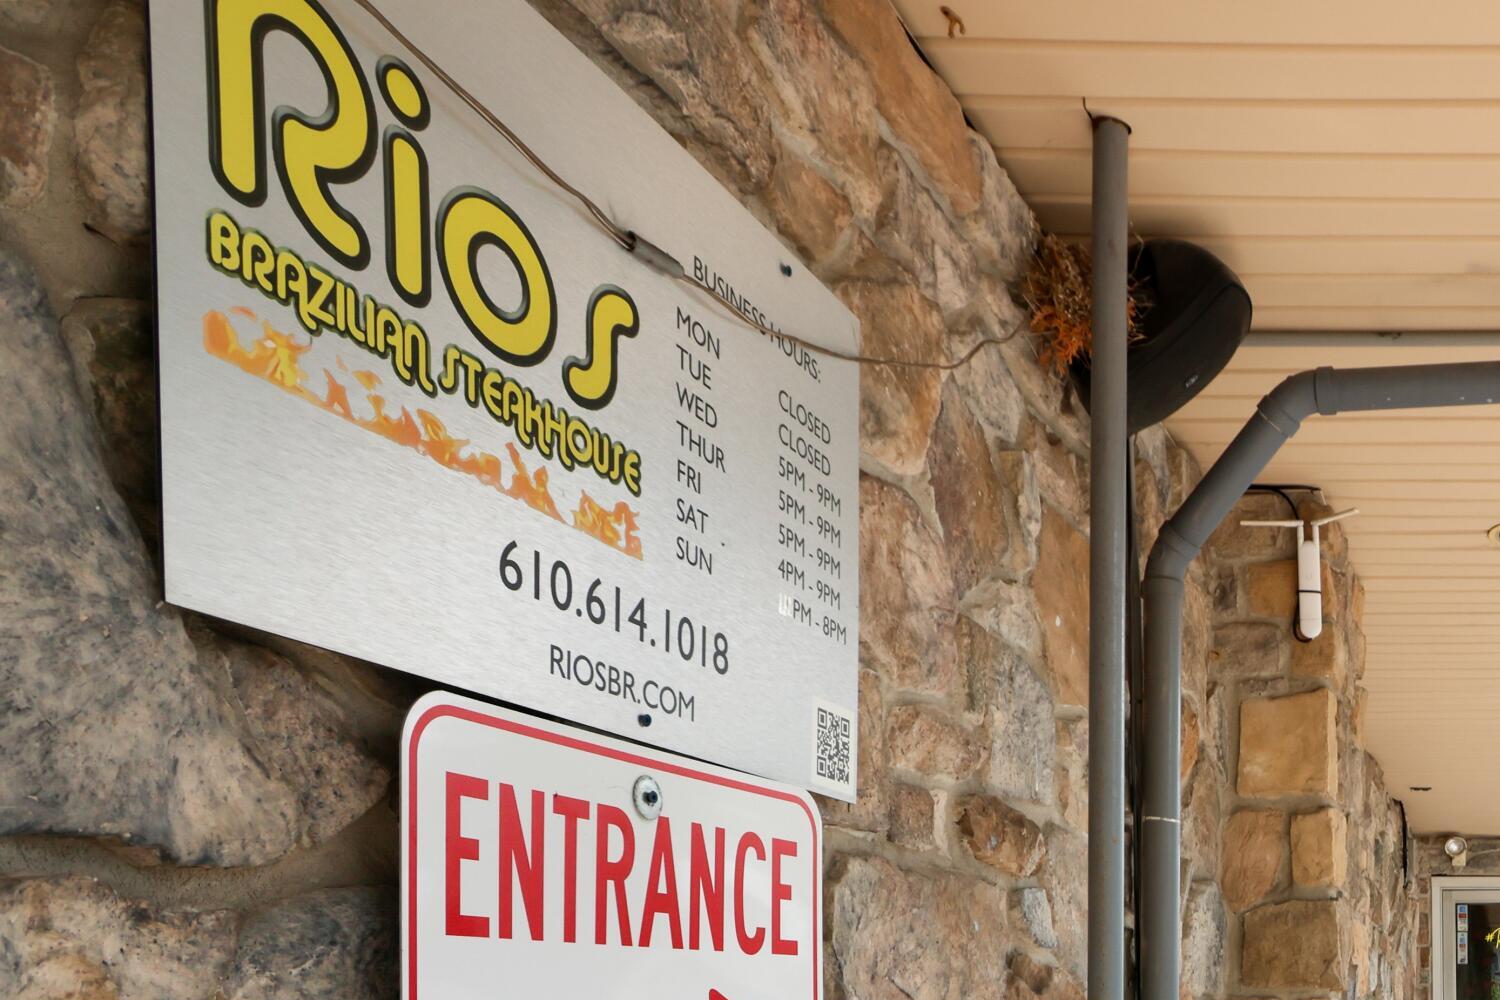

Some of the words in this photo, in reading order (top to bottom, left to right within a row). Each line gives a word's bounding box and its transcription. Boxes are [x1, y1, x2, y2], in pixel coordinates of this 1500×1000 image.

[207, 208, 437, 399] BRAZILIAN
[437, 344, 642, 498] STEAKHOUSE
[676, 306, 720, 360] MON
[778, 390, 831, 444] CLOSED
[694, 255, 767, 336] BUSINESS
[770, 321, 821, 383] HOURS:
[676, 344, 711, 390] TUE
[778, 423, 831, 476] CLOSED
[676, 381, 717, 428] WED
[778, 456, 805, 492] 5PM
[817, 484, 841, 517] 9PM
[676, 420, 725, 473] THUR
[778, 490, 805, 525] 5PM
[817, 516, 841, 548] 9PM
[677, 460, 701, 494] FRI
[778, 523, 805, 557] 5PM
[817, 548, 841, 579] 9PM
[499, 540, 729, 675] 610.614.1018
[676, 498, 709, 534] SAT
[778, 559, 805, 590] 4PM
[817, 580, 841, 610] 9PM
[676, 536, 712, 575] SUN
[823, 616, 847, 645] 8PM
[550, 644, 695, 722] RIOSBR.COM
[445, 771, 799, 956] ENTRANCE
